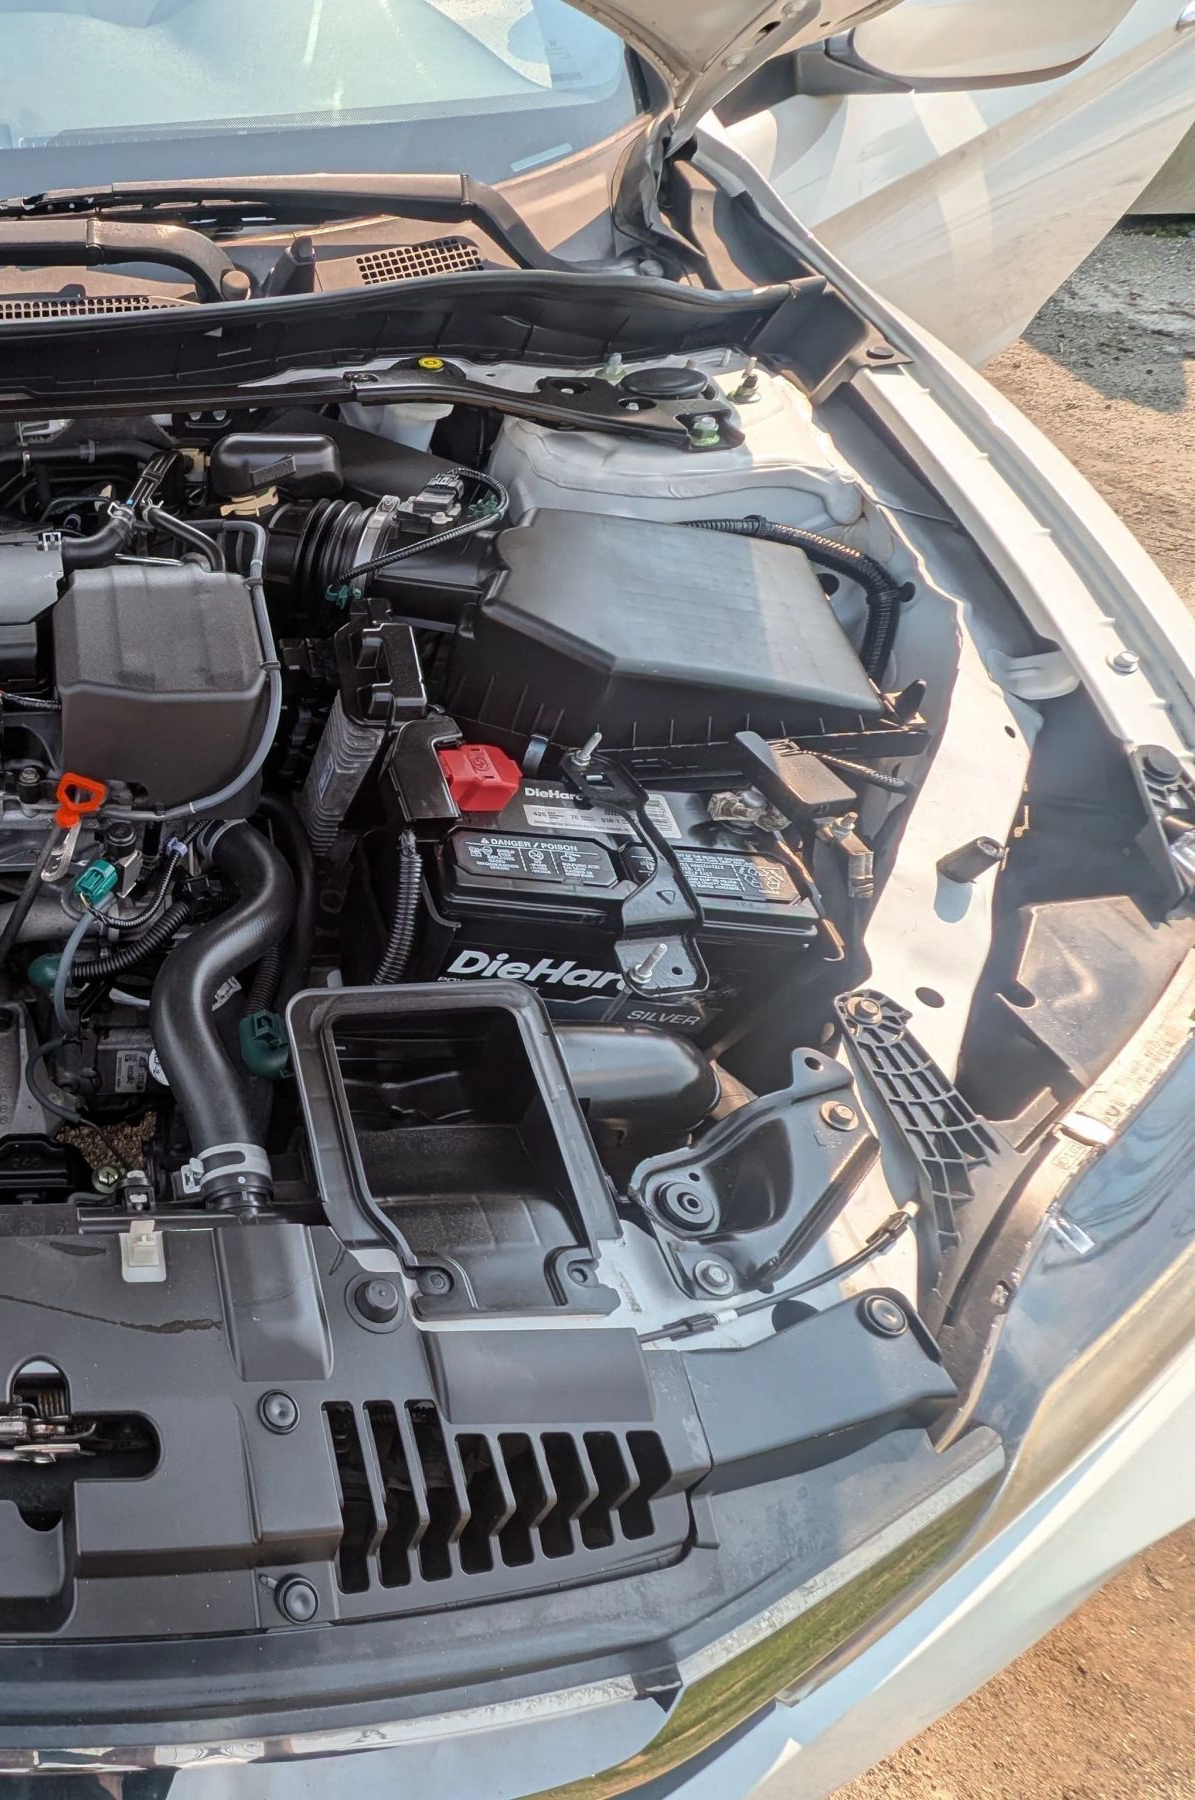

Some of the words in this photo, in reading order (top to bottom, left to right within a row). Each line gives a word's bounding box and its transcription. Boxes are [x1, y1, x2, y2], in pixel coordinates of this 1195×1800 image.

[490, 838, 531, 848] DANGER
[540, 842, 578, 852] POISON
[627, 1009, 701, 1026] SILVER
